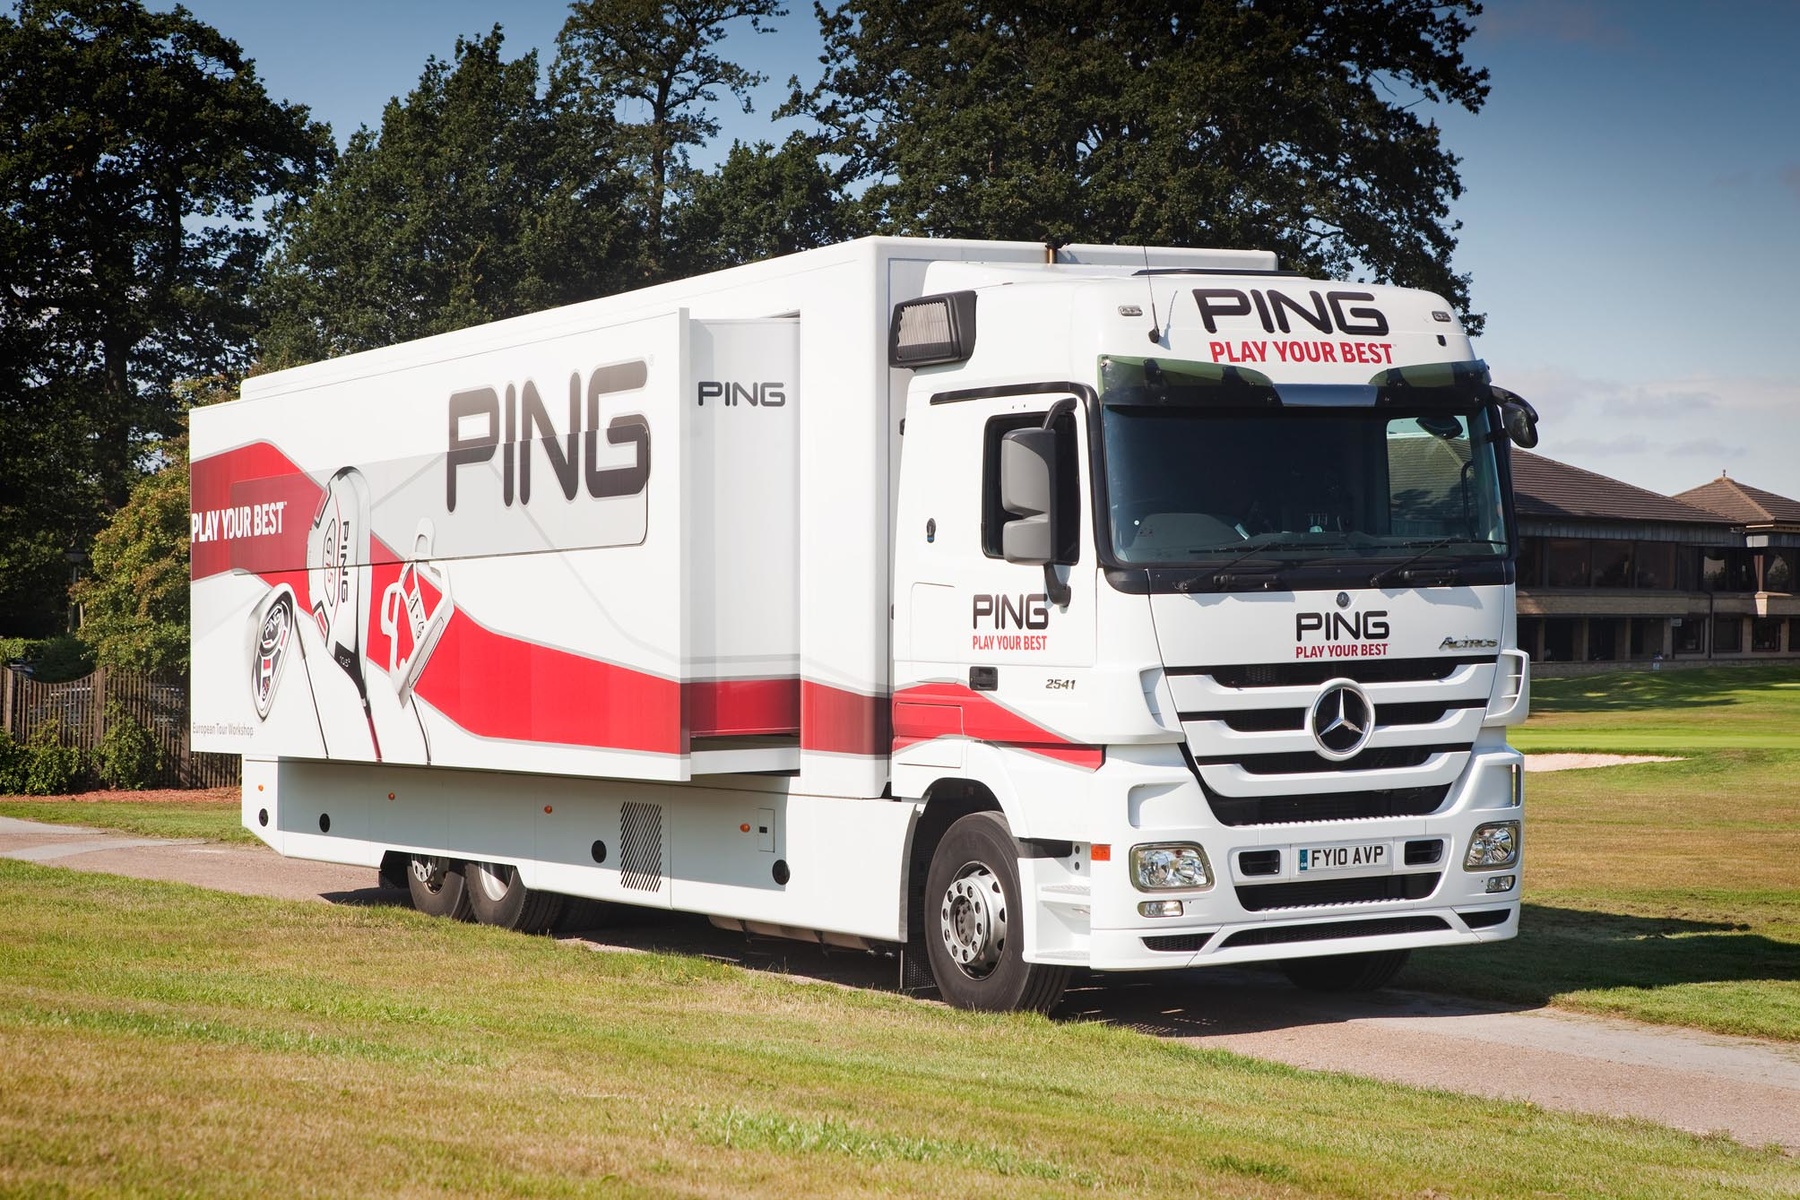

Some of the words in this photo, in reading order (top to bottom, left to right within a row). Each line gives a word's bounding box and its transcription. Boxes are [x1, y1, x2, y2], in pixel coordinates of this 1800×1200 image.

[1192, 288, 1390, 336] PING
[1209, 341, 1268, 363] PLAY
[1272, 341, 1338, 363] YOUR
[1339, 342, 1394, 364] BEST
[698, 381, 785, 407] PING
[447, 359, 651, 513] PING
[191, 510, 220, 543] PLAY
[221, 506, 252, 540] YOUR
[253, 501, 285, 536] BEST
[340, 521, 349, 604] PING
[972, 593, 1049, 630] PING
[1296, 610, 1390, 641] PING
[972, 635, 995, 650] PLAY
[996, 635, 1022, 650] YOUR
[1023, 635, 1047, 650] BEST
[1296, 645, 1325, 658] PLAY
[1327, 644, 1358, 657] YOUR
[1360, 643, 1388, 656] BEST
[1045, 678, 1076, 690] 2541
[193, 722, 215, 736] European
[216, 722, 227, 736] Tour
[228, 723, 254, 738] Workshop
[1311, 848, 1347, 867] FY10
[1352, 845, 1384, 864] AVP
